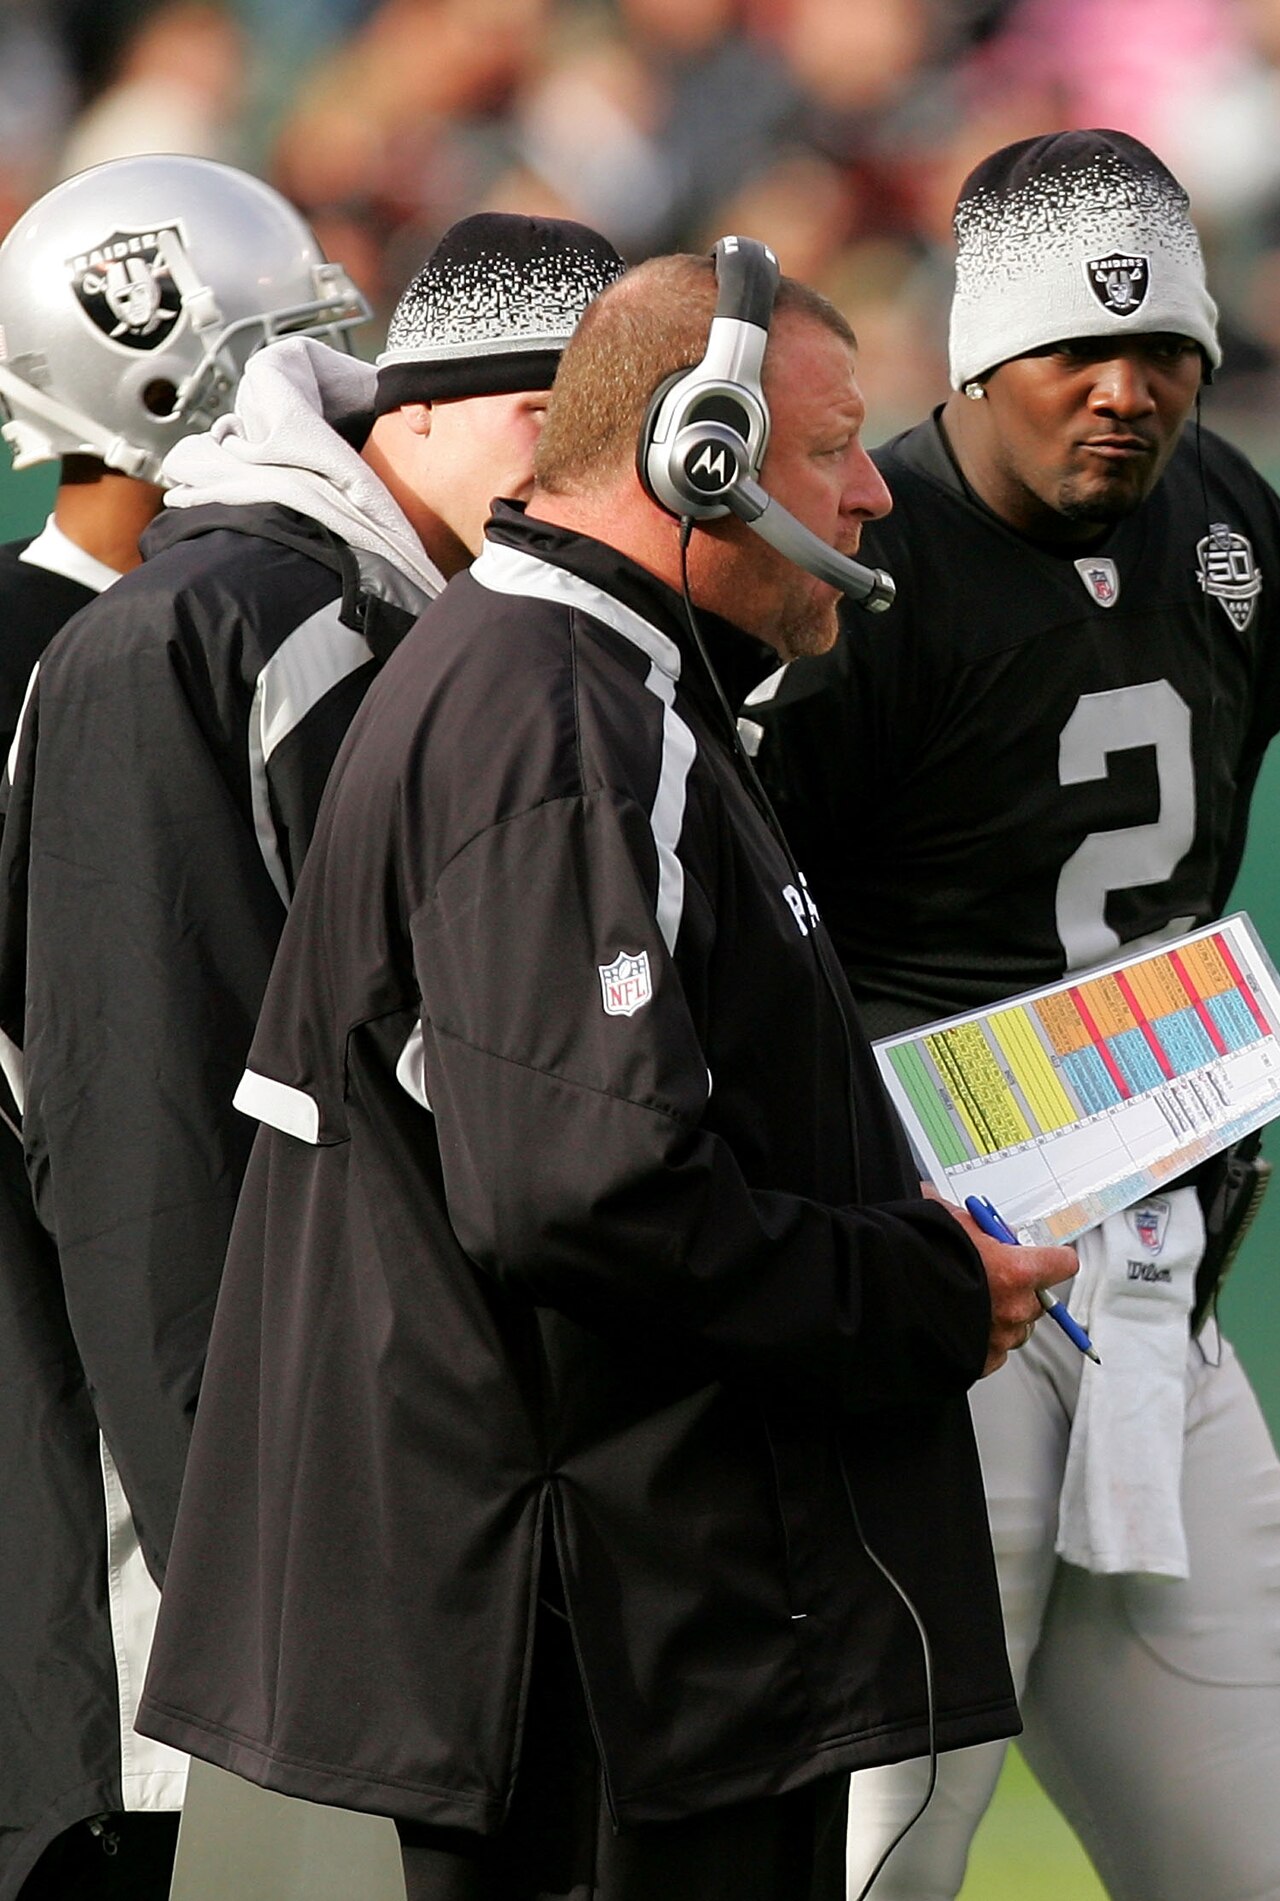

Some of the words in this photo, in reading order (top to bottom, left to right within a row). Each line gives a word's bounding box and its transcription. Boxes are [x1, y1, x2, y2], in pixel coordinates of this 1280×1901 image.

[73, 233, 159, 273] RAIDER
[1090, 258, 1143, 270] RAIDERS
[1203, 551, 1250, 581] 50
[1055, 679, 1196, 978] 2
[609, 978, 646, 1007] NFL
